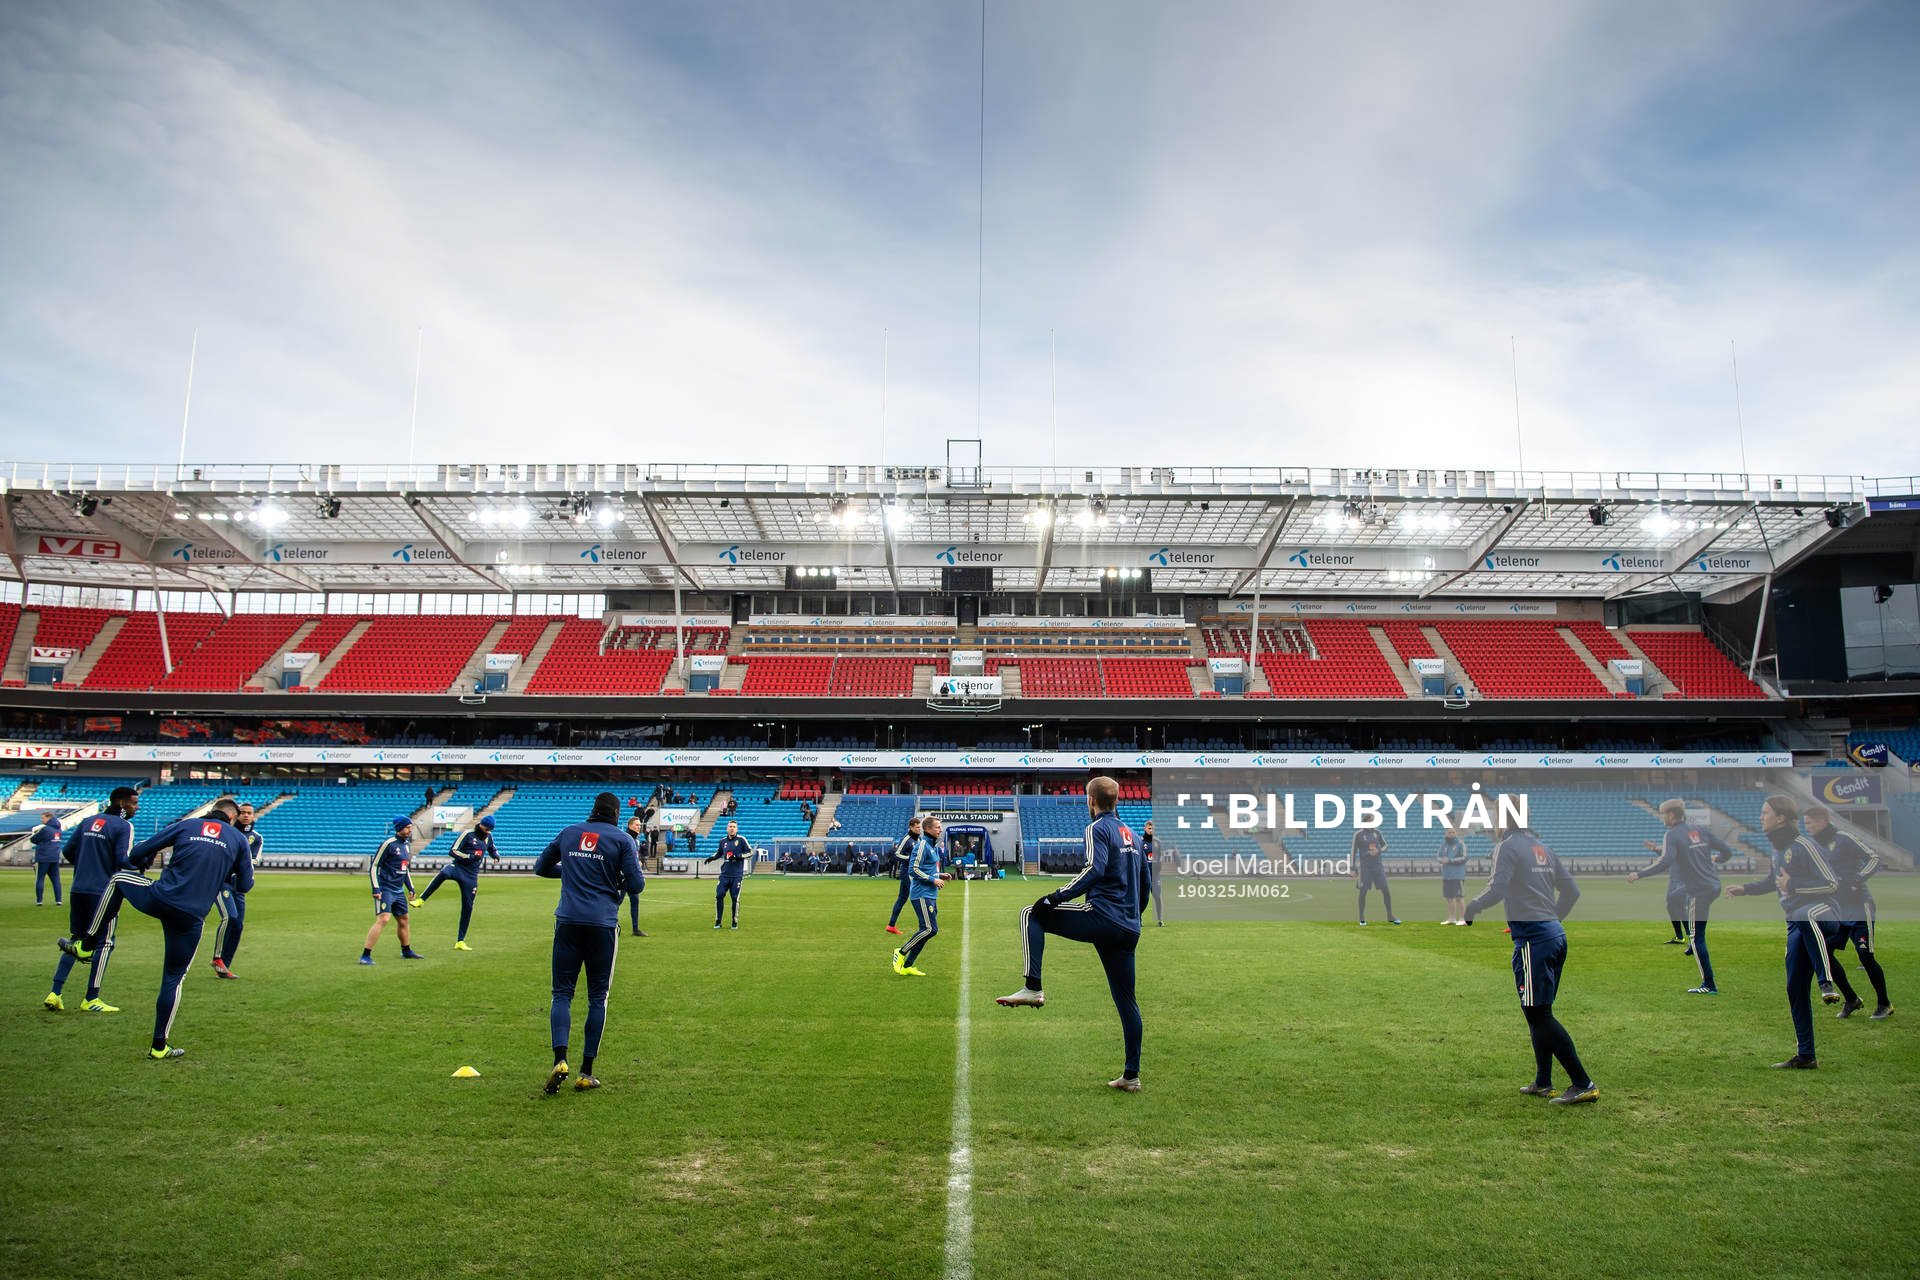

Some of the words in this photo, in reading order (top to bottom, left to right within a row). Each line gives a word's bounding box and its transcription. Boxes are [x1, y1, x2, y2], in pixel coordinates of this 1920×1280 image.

[38, 536, 121, 559] VG
[283, 549, 328, 559] telenor
[413, 549, 452, 560] teleno
[601, 549, 647, 560] telenor
[739, 550, 786, 561] telenor
[957, 551, 1003, 562] telenor
[1169, 552, 1215, 563] telenor
[1309, 554, 1354, 565] telenor
[1495, 556, 1540, 567] telenor
[1621, 557, 1664, 568] telenor
[1709, 558, 1751, 569] telenor
[33, 648, 73, 658] VG
[957, 680, 994, 690] telenor
[26, 748, 71, 758] VG
[75, 749, 117, 759] VG
[269, 751, 294, 759] telenor
[1861, 744, 1886, 757] Bendit
[383, 752, 409, 760] telenor
[441, 752, 467, 760] telenor
[500, 753, 525, 761] telenor
[557, 753, 584, 761] telenor
[675, 754, 701, 762] telenor
[734, 754, 760, 762] telenor
[793, 755, 819, 763] telenor
[851, 755, 877, 763] telenor
[910, 755, 937, 763] telenor
[1028, 756, 1055, 764] telenor
[1087, 756, 1113, 764] telenor
[1146, 756, 1172, 764] telenor
[1715, 756, 1739, 764] telenor
[1836, 776, 1870, 796] Bendit
[190, 836, 215, 844] SVENSKA
[215, 840, 227, 848] SPEL
